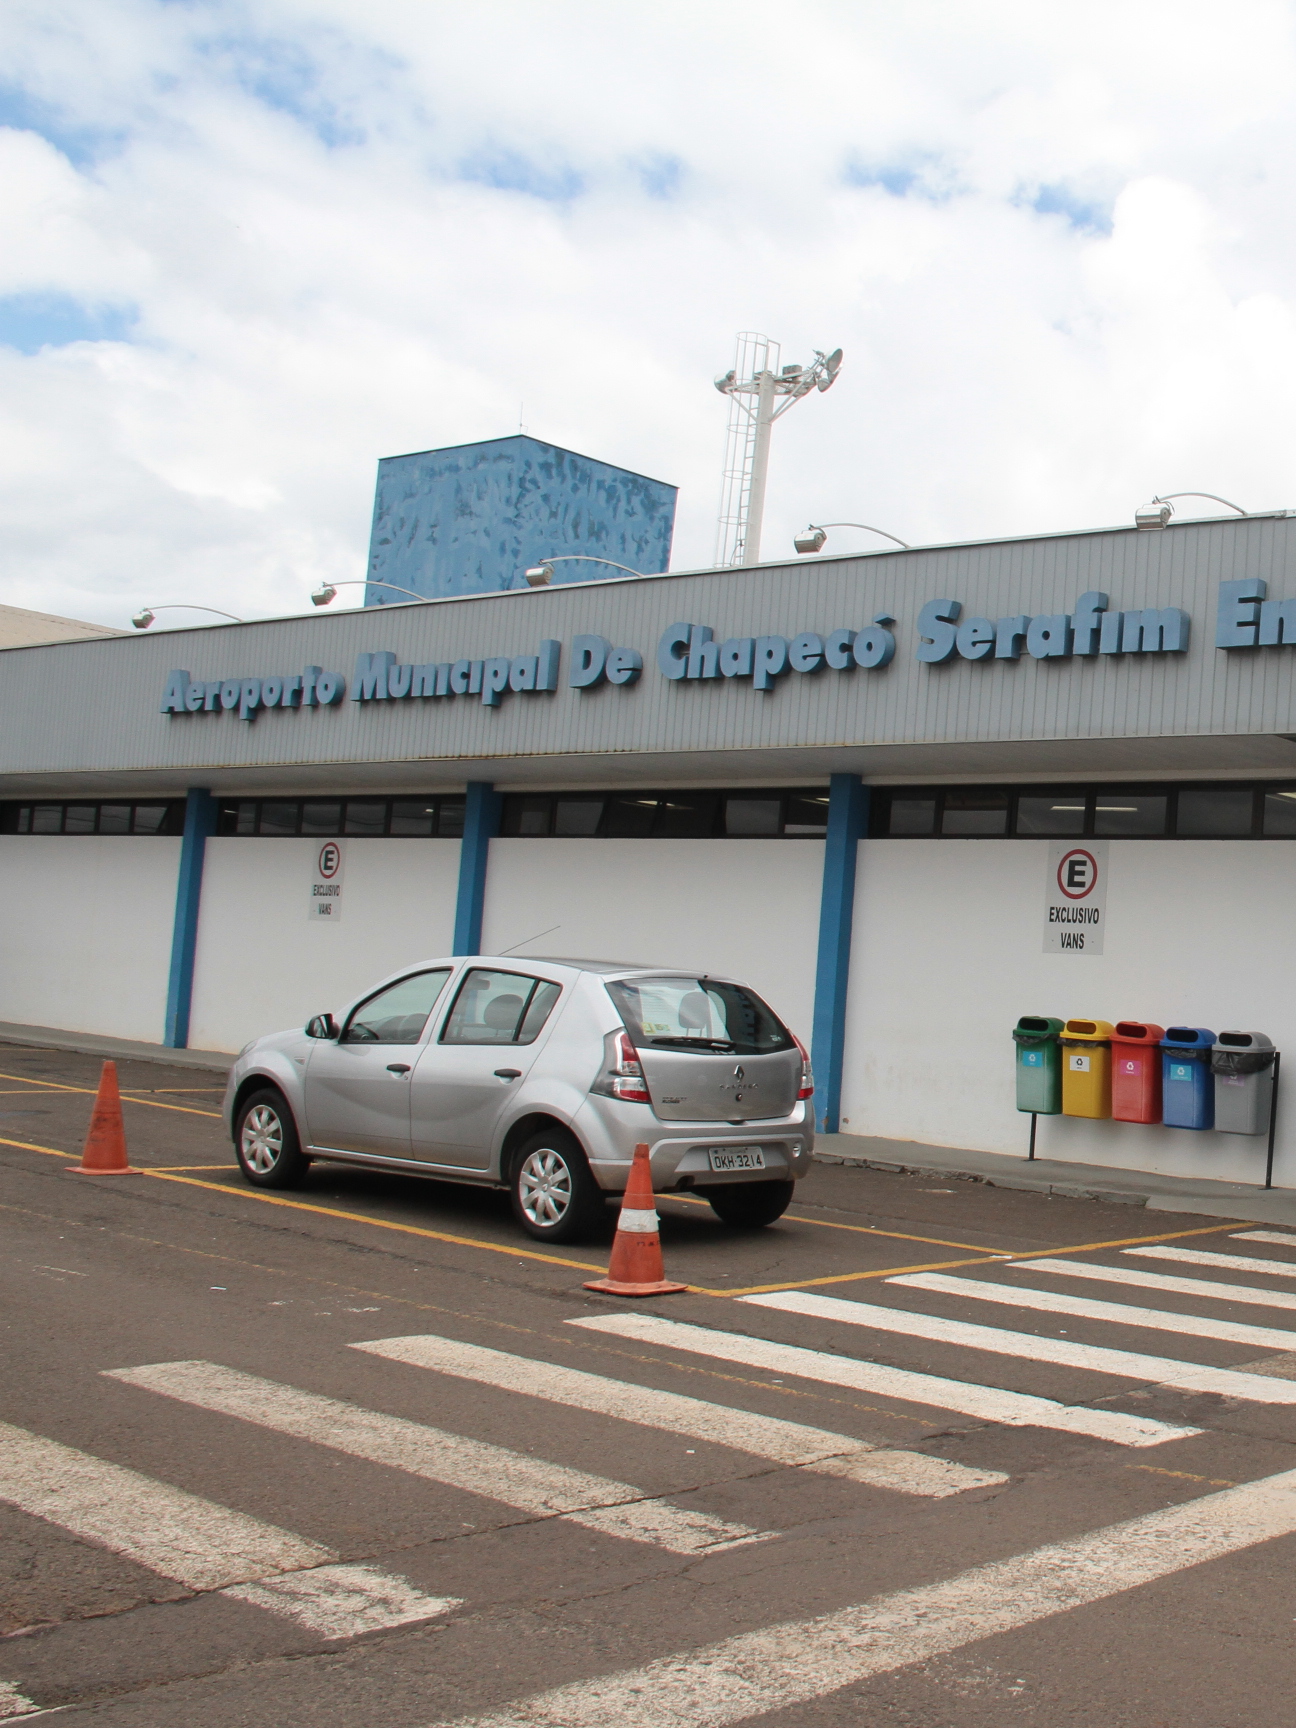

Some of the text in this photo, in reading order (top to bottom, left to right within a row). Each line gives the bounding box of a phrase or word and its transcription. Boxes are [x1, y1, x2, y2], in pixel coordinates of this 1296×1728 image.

[160, 669, 346, 721] Aeroporto
[351, 638, 561, 707] Municipal
[570, 633, 643, 688] De
[656, 613, 896, 692] Chapecó
[914, 591, 1190, 664] Serafim
[1067, 859, 1087, 888] E
[313, 884, 340, 896] EXCLUSIVO
[318, 903, 332, 915] VANS
[1049, 906, 1100, 925] EXCLUSIVO
[1060, 932, 1084, 949] VANS
